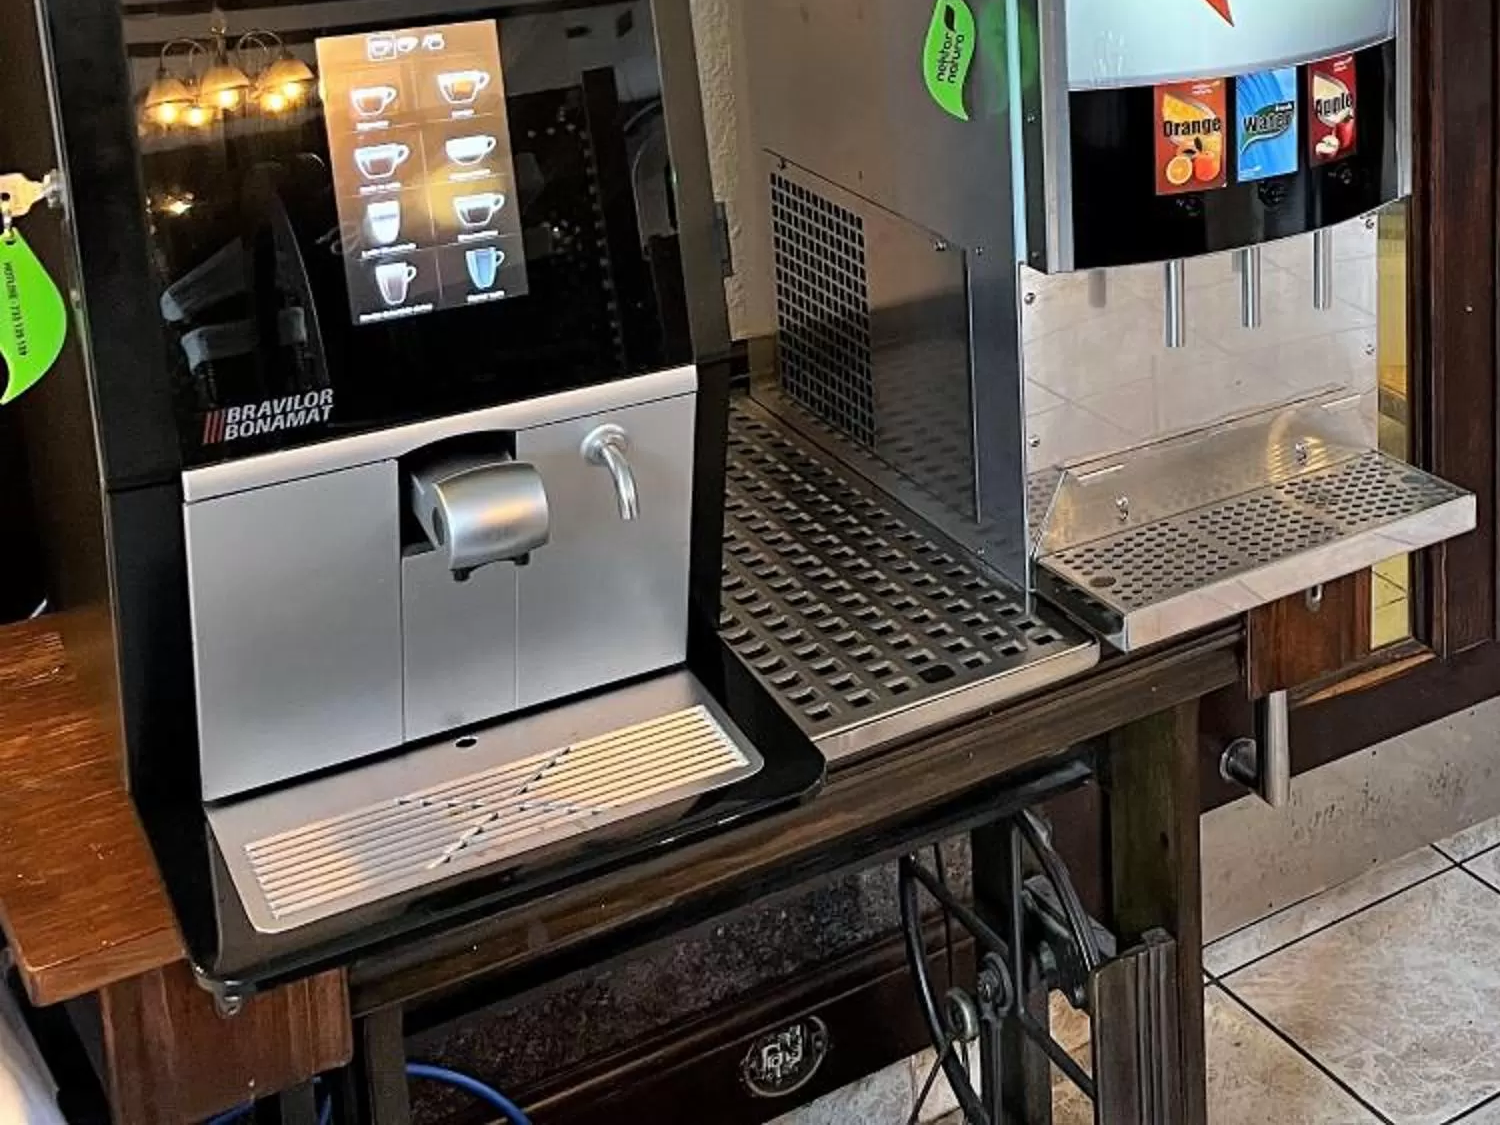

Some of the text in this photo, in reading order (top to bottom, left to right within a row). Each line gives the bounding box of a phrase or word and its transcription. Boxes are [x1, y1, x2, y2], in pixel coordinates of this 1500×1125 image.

[1315, 92, 1353, 117] Apple
[1163, 118, 1221, 138] Orange
[1243, 110, 1293, 135] Water
[225, 388, 334, 424] BRAVILOR
[224, 404, 334, 442] BONAMAT
